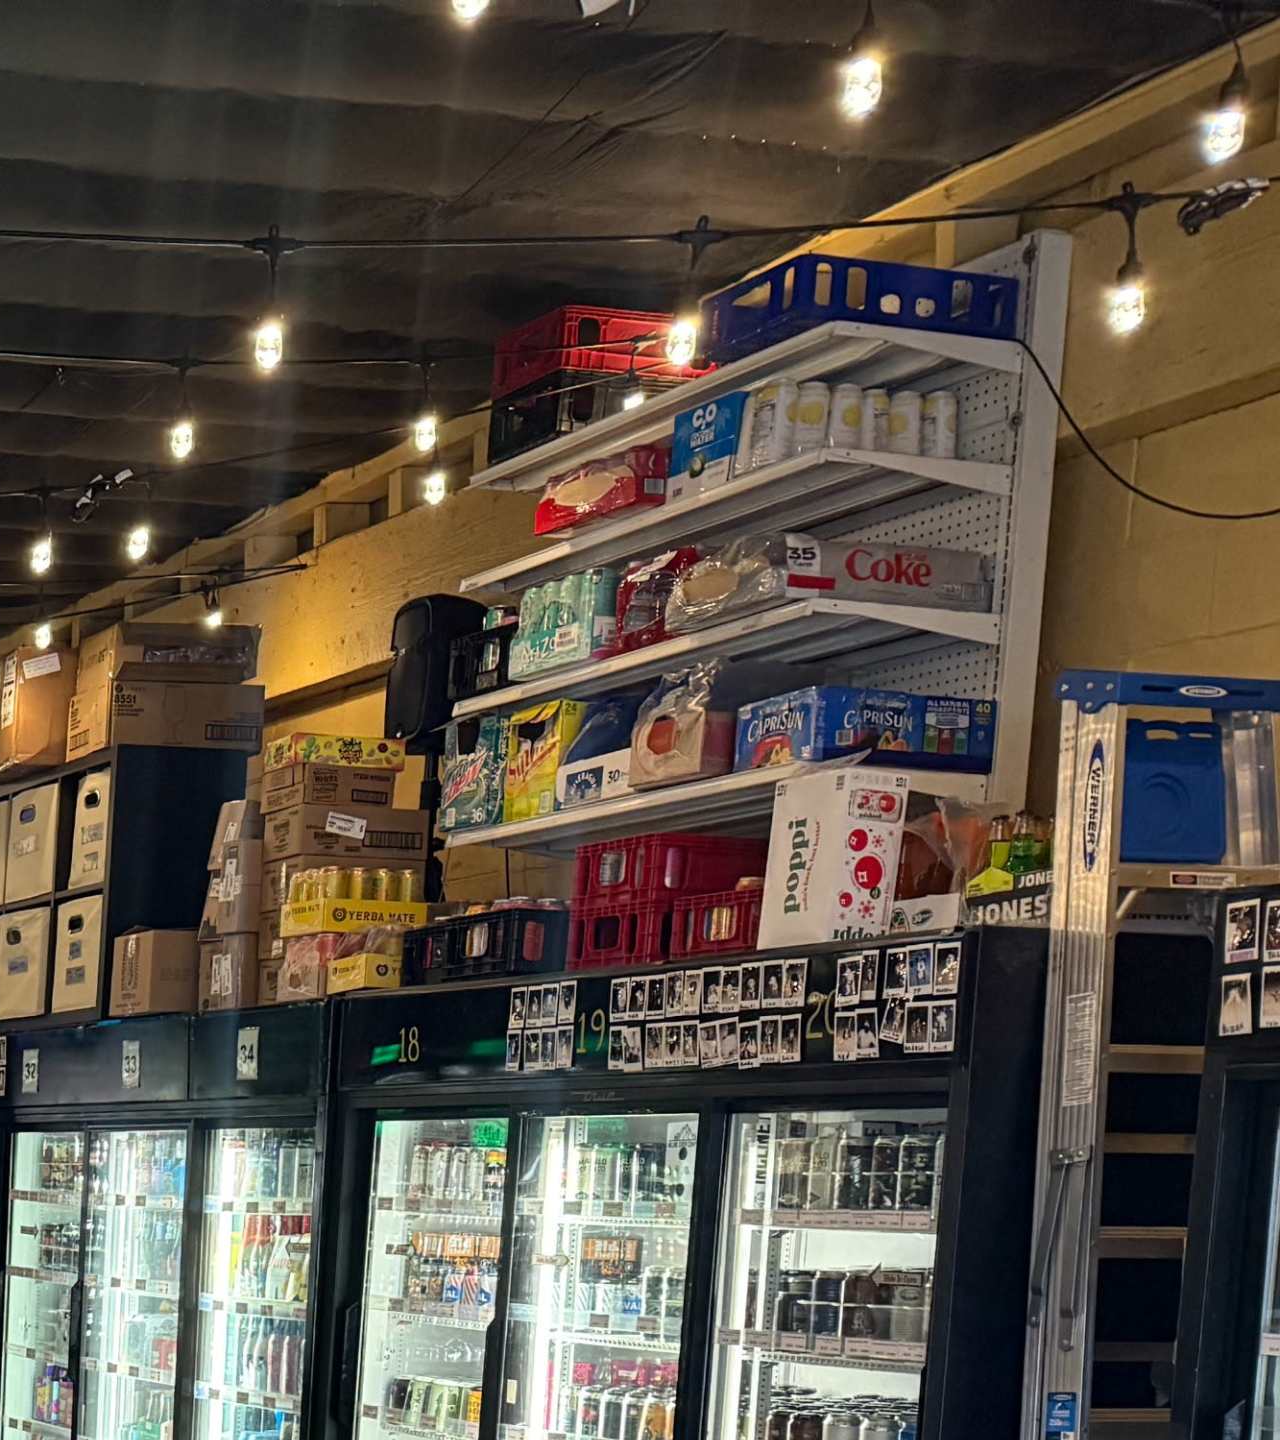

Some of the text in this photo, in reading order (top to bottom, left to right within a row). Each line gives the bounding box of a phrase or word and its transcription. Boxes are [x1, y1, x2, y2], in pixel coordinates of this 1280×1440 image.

[788, 546, 817, 561] 35
[845, 548, 933, 588] Coke
[565, 702, 577, 713] 24
[975, 702, 991, 714] 40
[608, 769, 621, 784] 30
[1086, 766, 1102, 846] WERNER
[470, 807, 484, 824] 36
[784, 816, 810, 914] poppi
[1017, 871, 1054, 889] JONE
[348, 910, 417, 925] YERBA MATE
[976, 899, 1049, 926] JONES
[576, 1008, 606, 1054] 19
[241, 1043, 255, 1064] 34
[398, 1026, 420, 1063] 18
[25, 1062, 36, 1080] 32
[124, 1055, 137, 1074] 33
